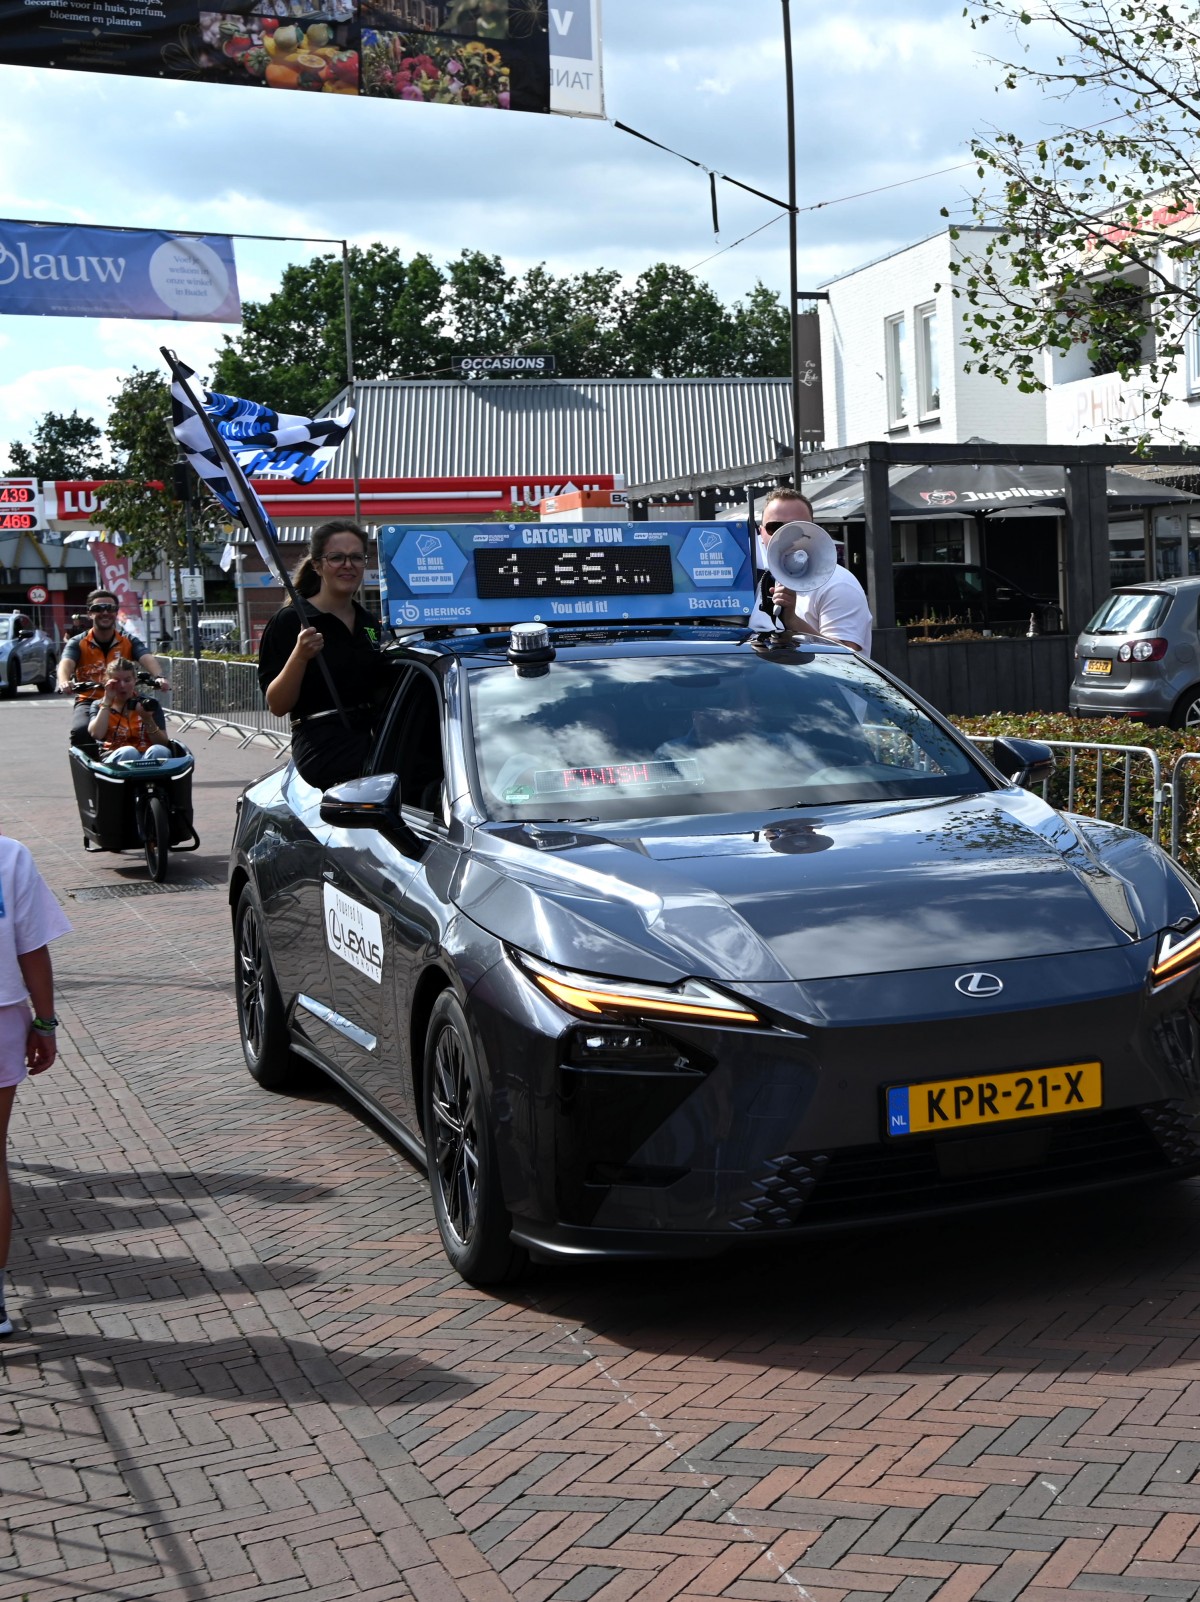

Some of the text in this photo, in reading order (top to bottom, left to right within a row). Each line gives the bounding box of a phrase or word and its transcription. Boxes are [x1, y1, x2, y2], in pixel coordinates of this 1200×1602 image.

[93, 3, 102, 11] in
[104, 3, 127, 14] huis,
[129, 7, 166, 18] parfum,
[50, 10, 90, 22] bloemen
[106, 16, 142, 27] planten
[461, 358, 545, 369] OCCASIONS
[961, 487, 1055, 502] Jupiler
[522, 528, 623, 544] CATCH-UP RUN
[417, 557, 426, 565] DE
[700, 552, 709, 560] DE
[551, 600, 608, 614] You did it!
[688, 597, 740, 609] Bavaria
[424, 607, 471, 616] BIERINGS
[563, 764, 649, 788] FINISH
[341, 923, 381, 969] LEXUS
[927, 1070, 1084, 1123] KPR-21-X
[892, 1116, 907, 1126] NL
